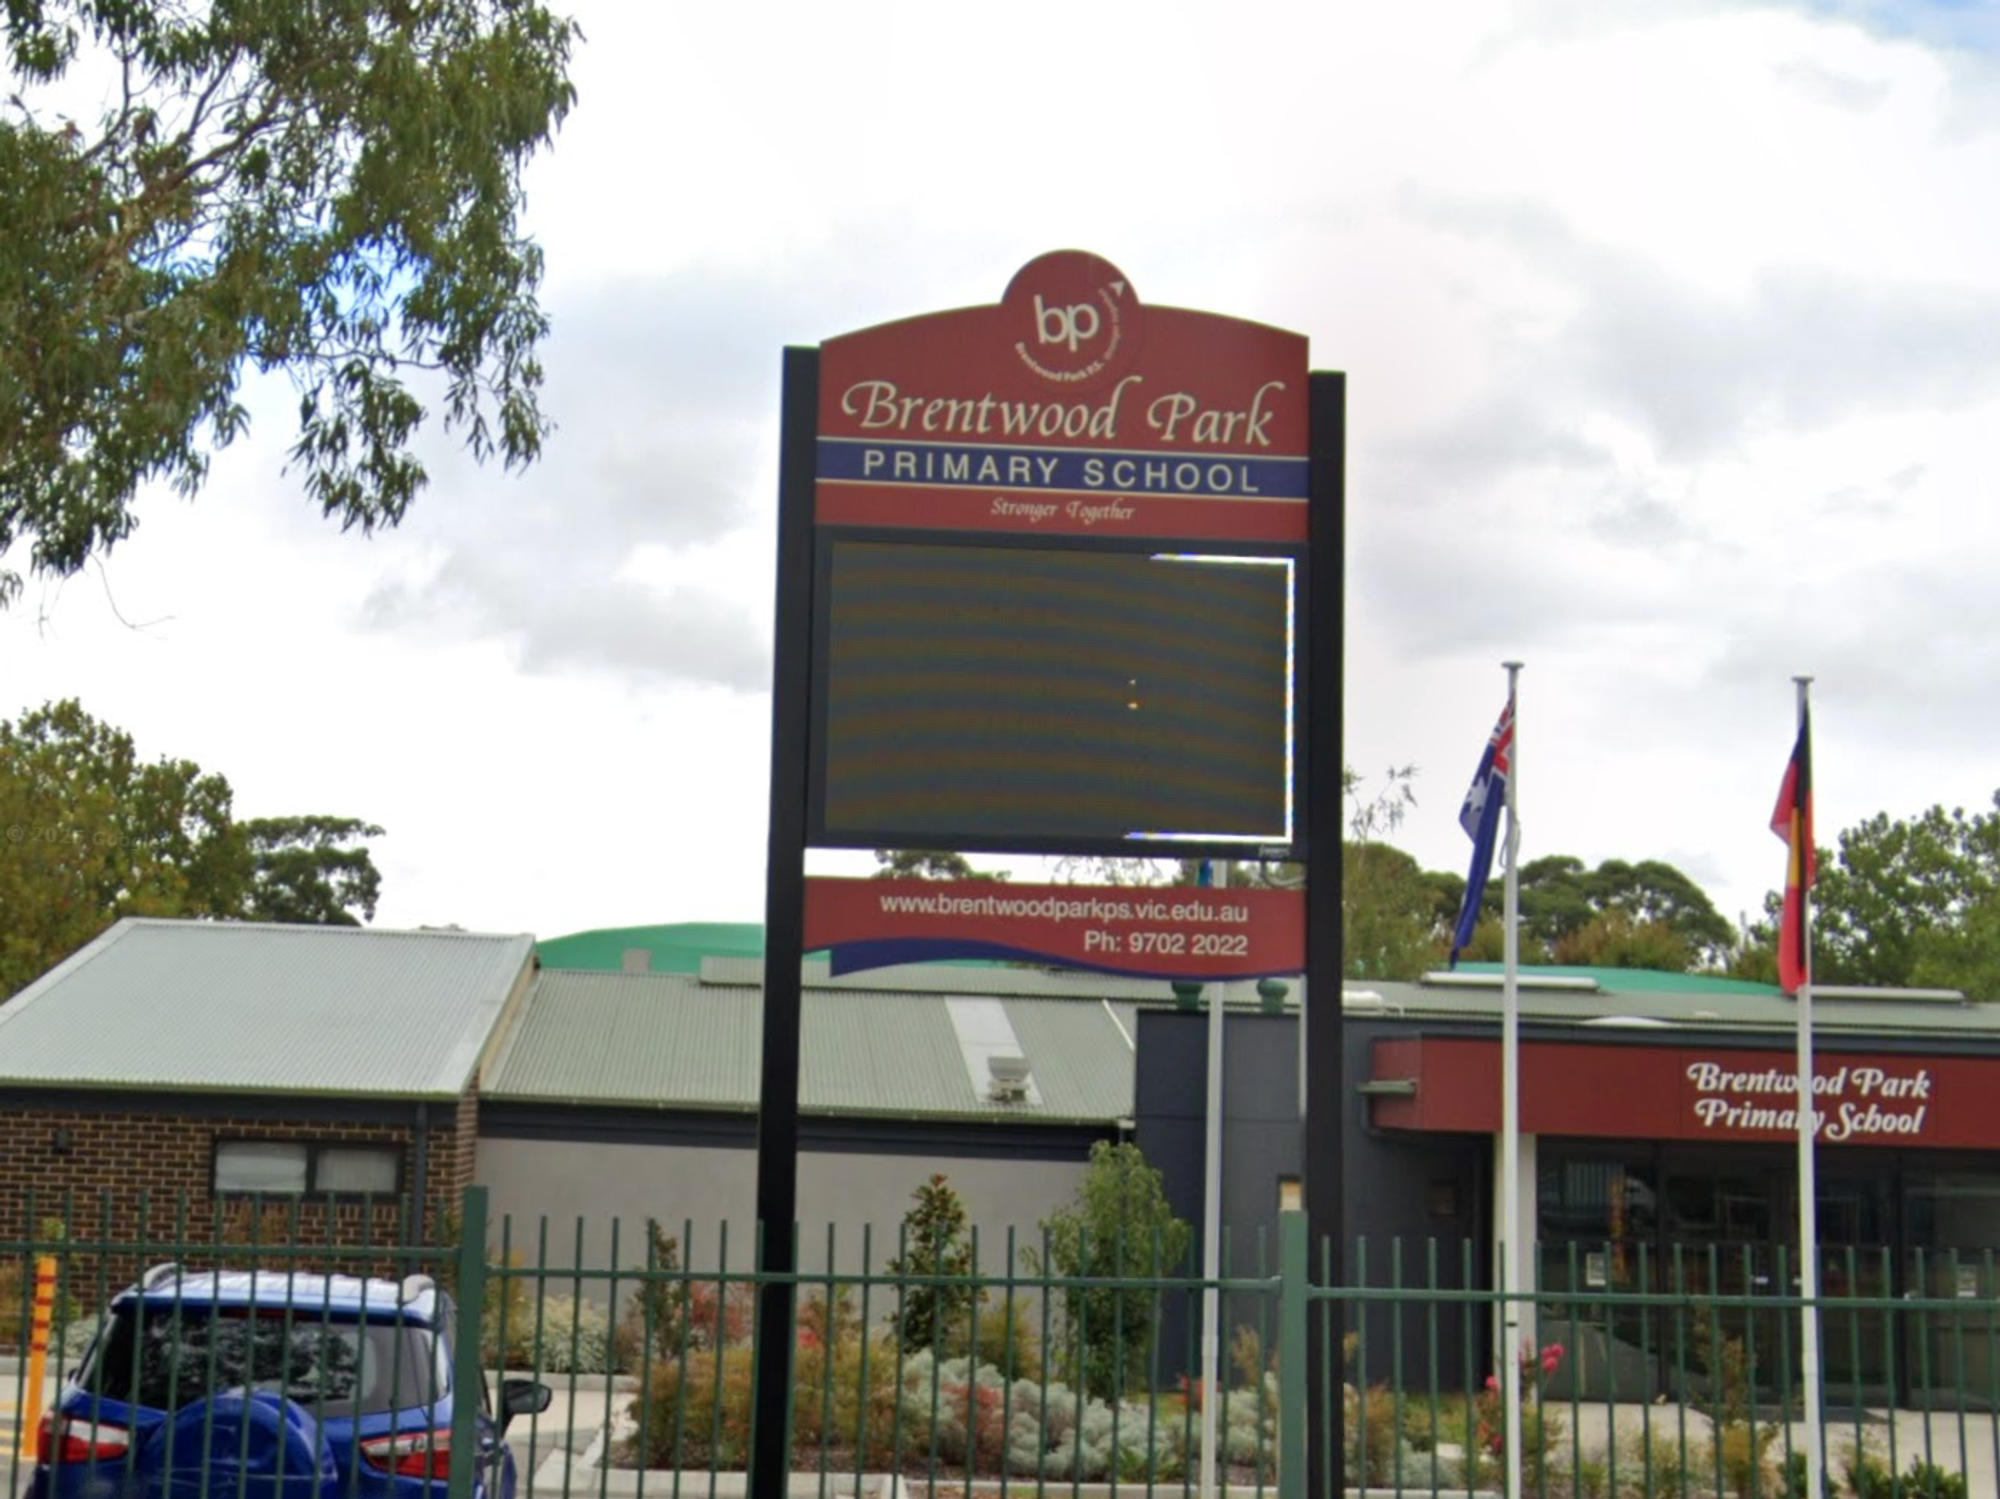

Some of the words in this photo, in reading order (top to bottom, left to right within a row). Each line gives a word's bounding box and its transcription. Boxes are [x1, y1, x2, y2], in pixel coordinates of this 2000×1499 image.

[1034, 295, 1099, 352] bp
[842, 376, 1142, 439] Brentwood
[1147, 381, 1285, 447] Park
[864, 450, 1058, 483] PRIMARY
[1084, 459, 1258, 492] SCHOOL
[991, 497, 1058, 523] Stronger
[1066, 498, 1136, 525] Together
[881, 894, 1249, 922] www.brentwoodparkps.vic.edu.au
[1085, 931, 1123, 953] Ph:
[1129, 932, 1185, 954] 9702
[1192, 934, 1248, 956] 2022
[1687, 1062, 1848, 1096] Brentwod
[1850, 1067, 1930, 1099] Park
[1694, 1098, 1825, 1137] Primay
[1824, 1102, 1926, 1142] School
